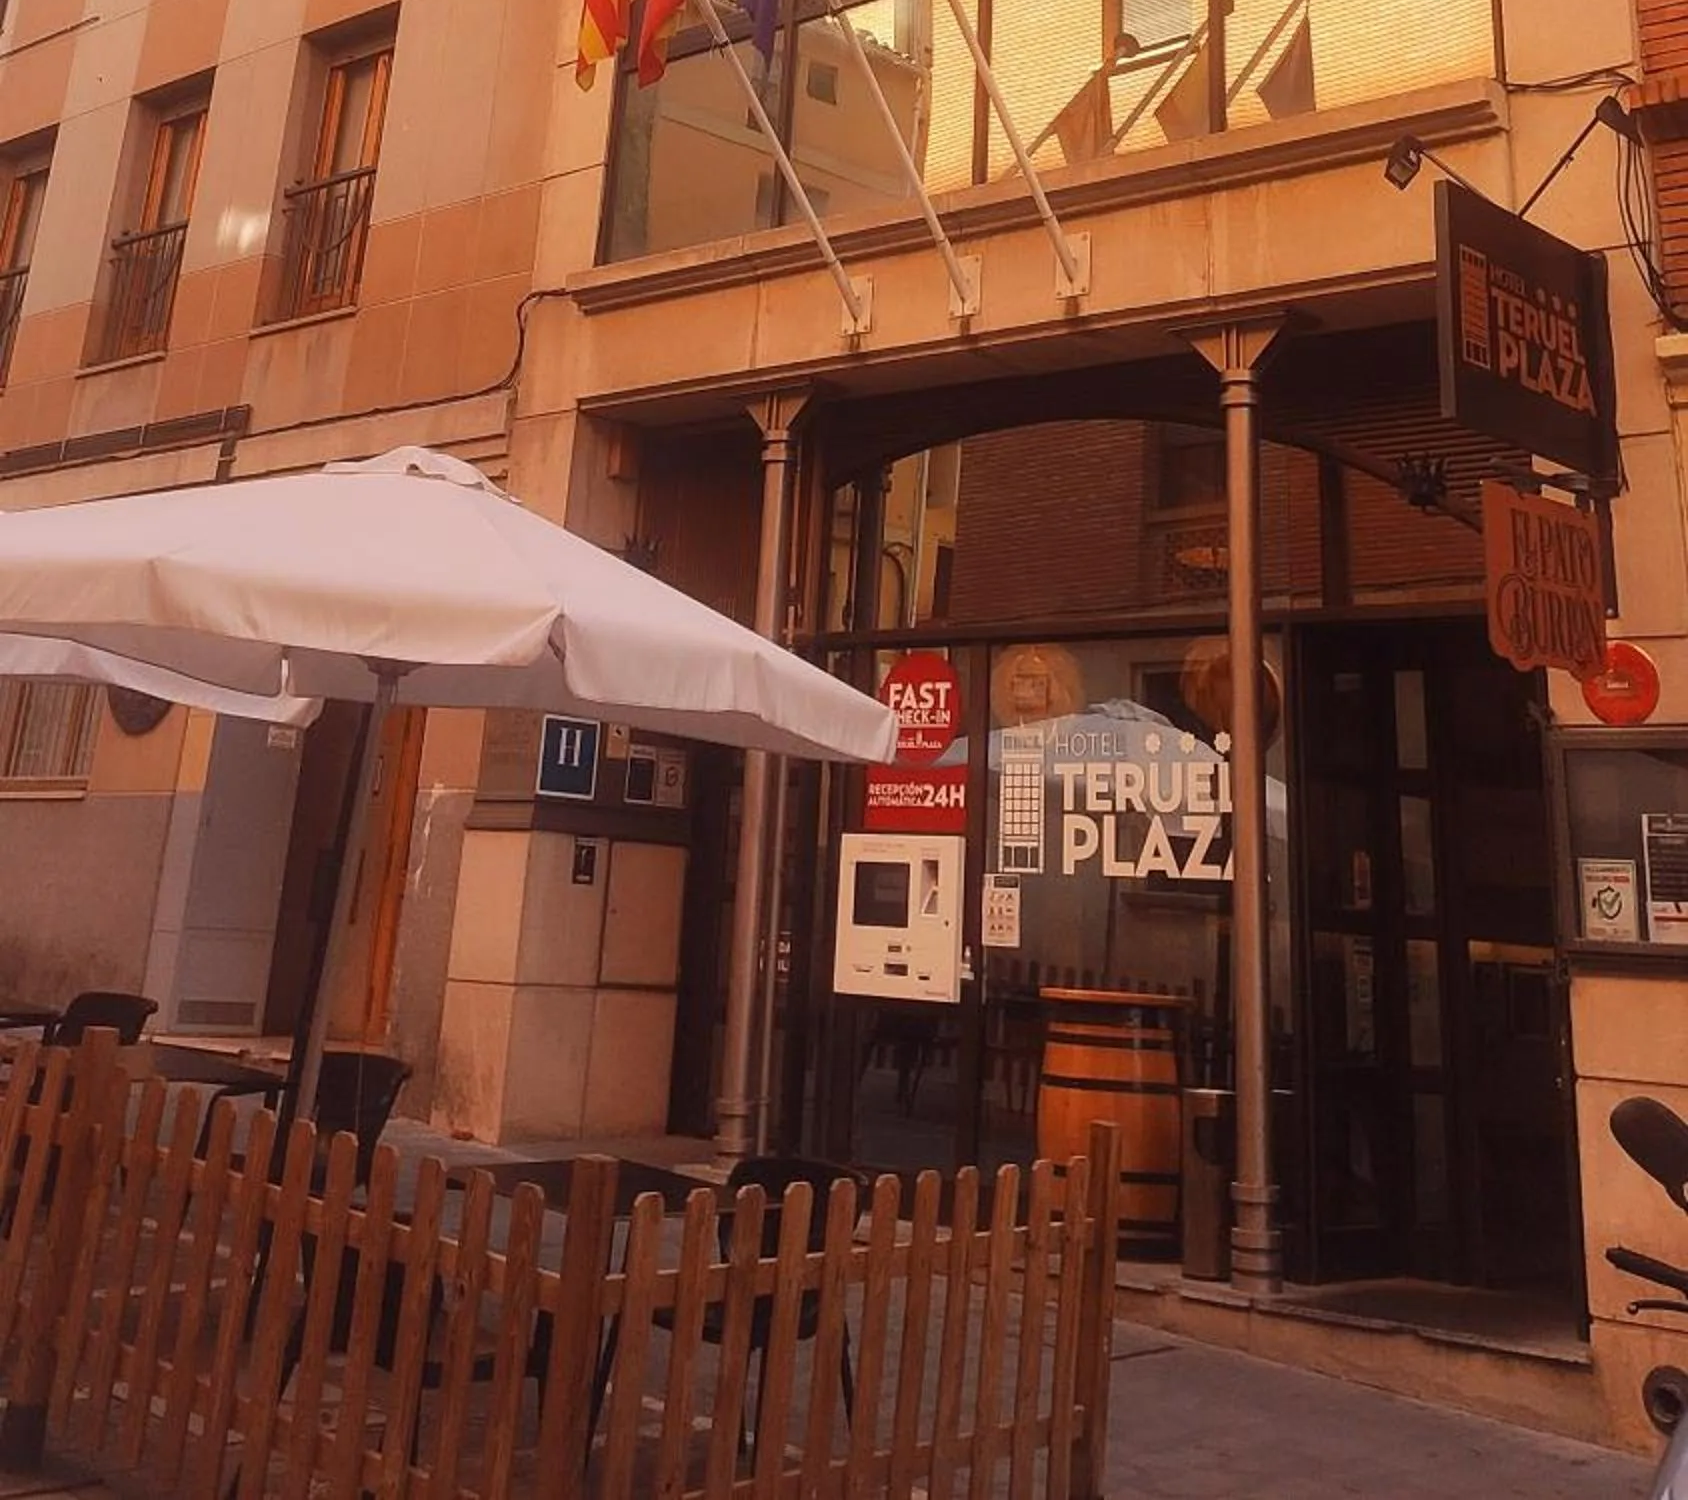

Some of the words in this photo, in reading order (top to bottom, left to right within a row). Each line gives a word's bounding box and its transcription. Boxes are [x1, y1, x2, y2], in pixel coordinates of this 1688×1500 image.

[1489, 263, 1526, 295] HOTEL
[1491, 286, 1586, 365] TERUEL
[1499, 330, 1598, 417] PLAZA
[889, 682, 952, 709] FAST
[896, 709, 951, 724] HECK-IN
[557, 727, 583, 767] H
[1055, 732, 1126, 757] HOTEL
[923, 783, 965, 808] 24H
[1062, 813, 1234, 881] PLAZ
